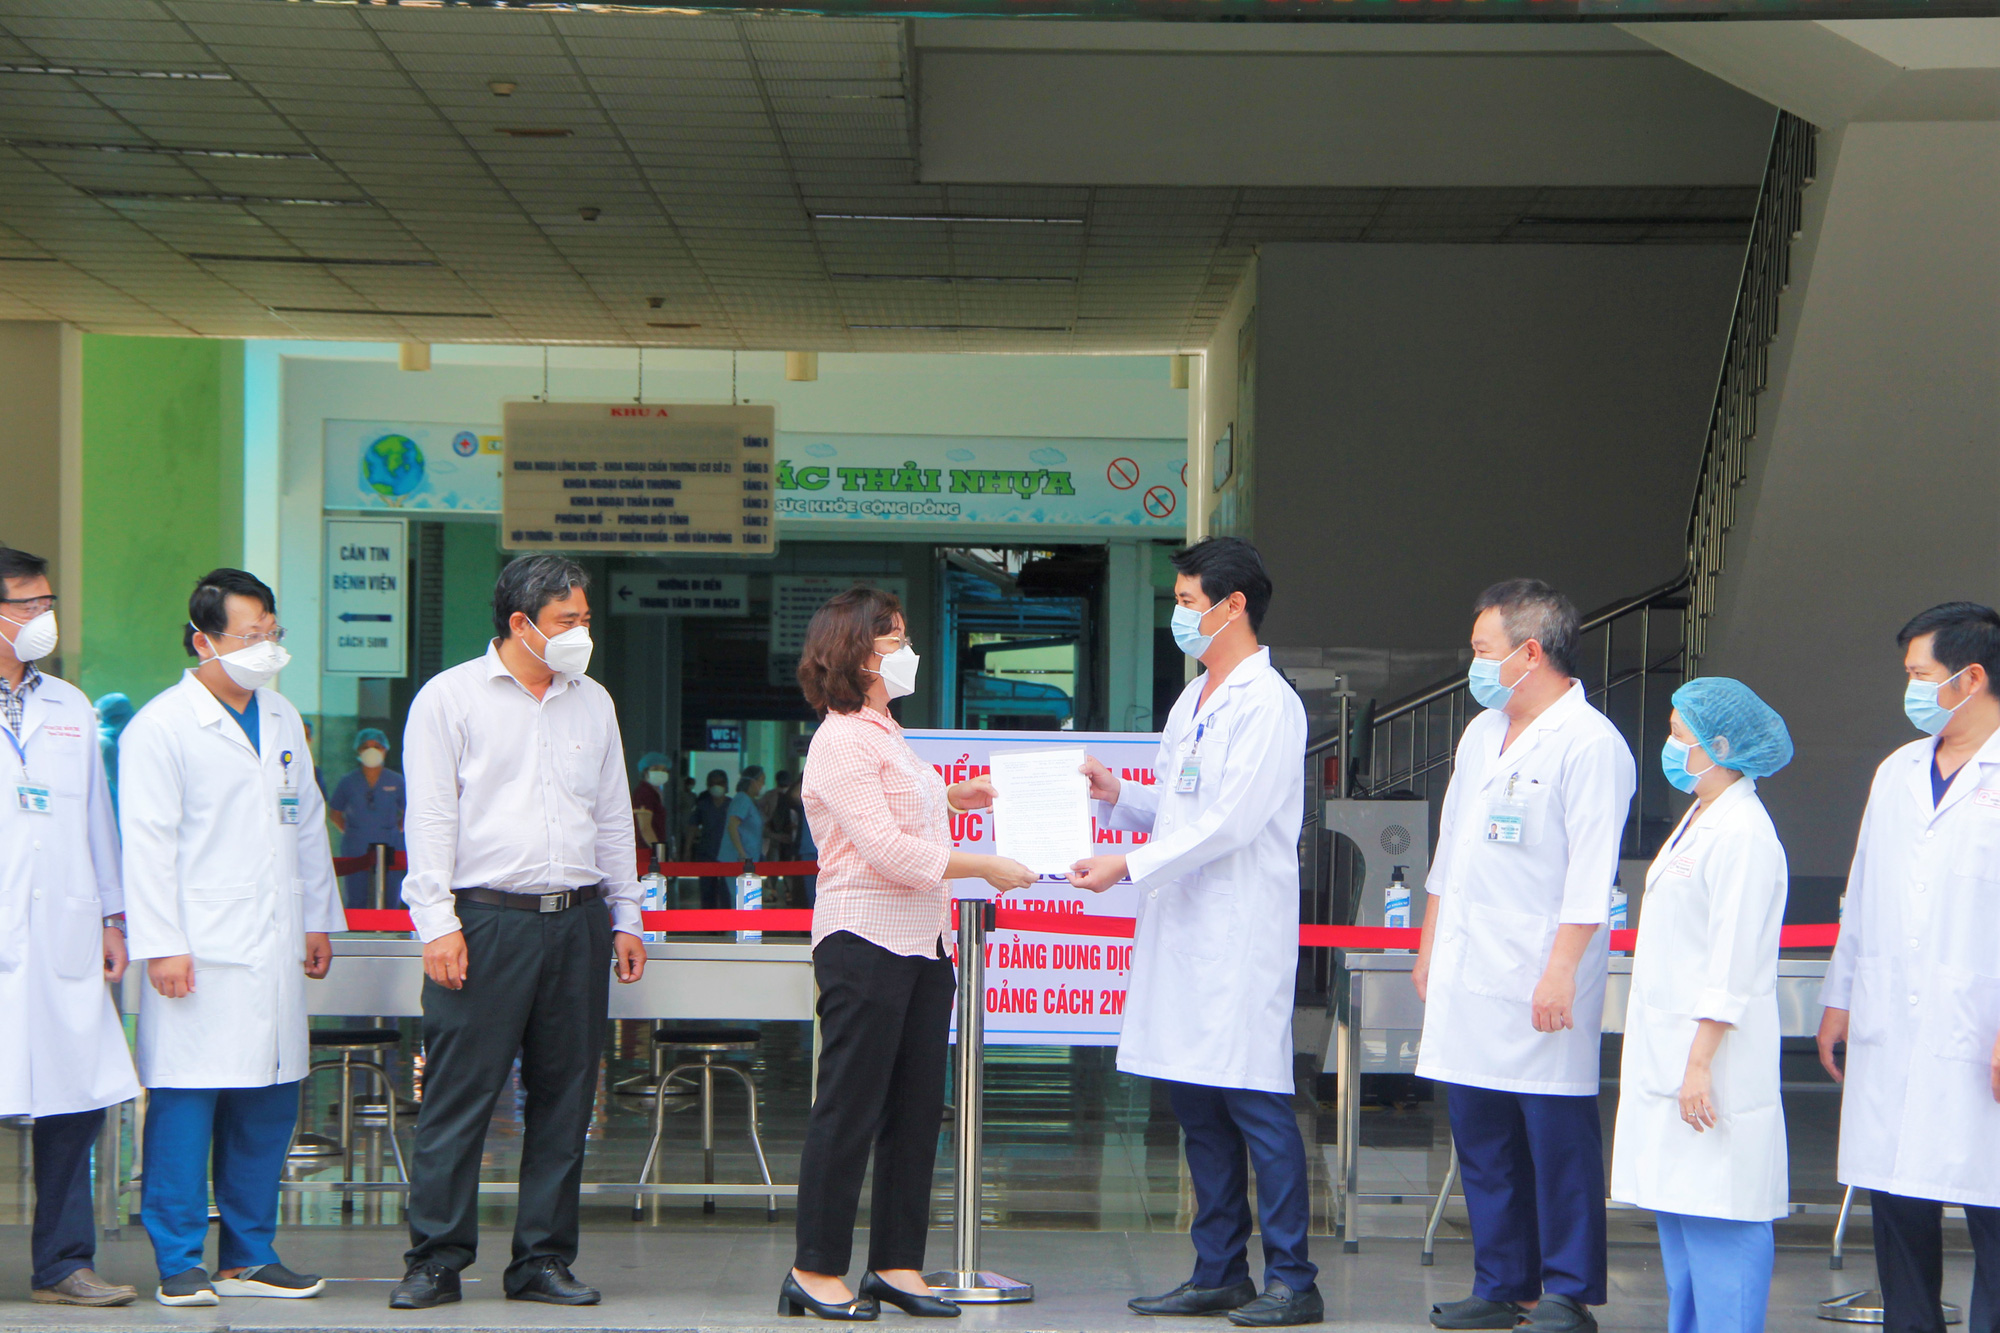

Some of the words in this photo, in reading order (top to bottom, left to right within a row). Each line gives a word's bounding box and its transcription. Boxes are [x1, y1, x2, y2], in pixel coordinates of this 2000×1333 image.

[611, 407, 651, 417] KHU
[656, 408, 669, 417] A
[563, 479, 587, 490] KHOA
[837, 461, 941, 493] THẢI
[949, 469, 1076, 500] NHỰA
[570, 496, 594, 507] KHOA
[652, 497, 675, 508] KINH
[808, 497, 857, 514] KHỎE
[860, 500, 908, 516] CỘNG
[369, 546, 390, 561] TIN
[333, 573, 366, 593] BỆNH
[368, 573, 397, 594] VIỆN
[711, 728, 730, 741] WC
[999, 933, 1047, 970] BẰNG
[1053, 944, 1101, 971] DUNG
[1043, 983, 1094, 1015] CÁCH
[1099, 989, 1127, 1016] 2M
